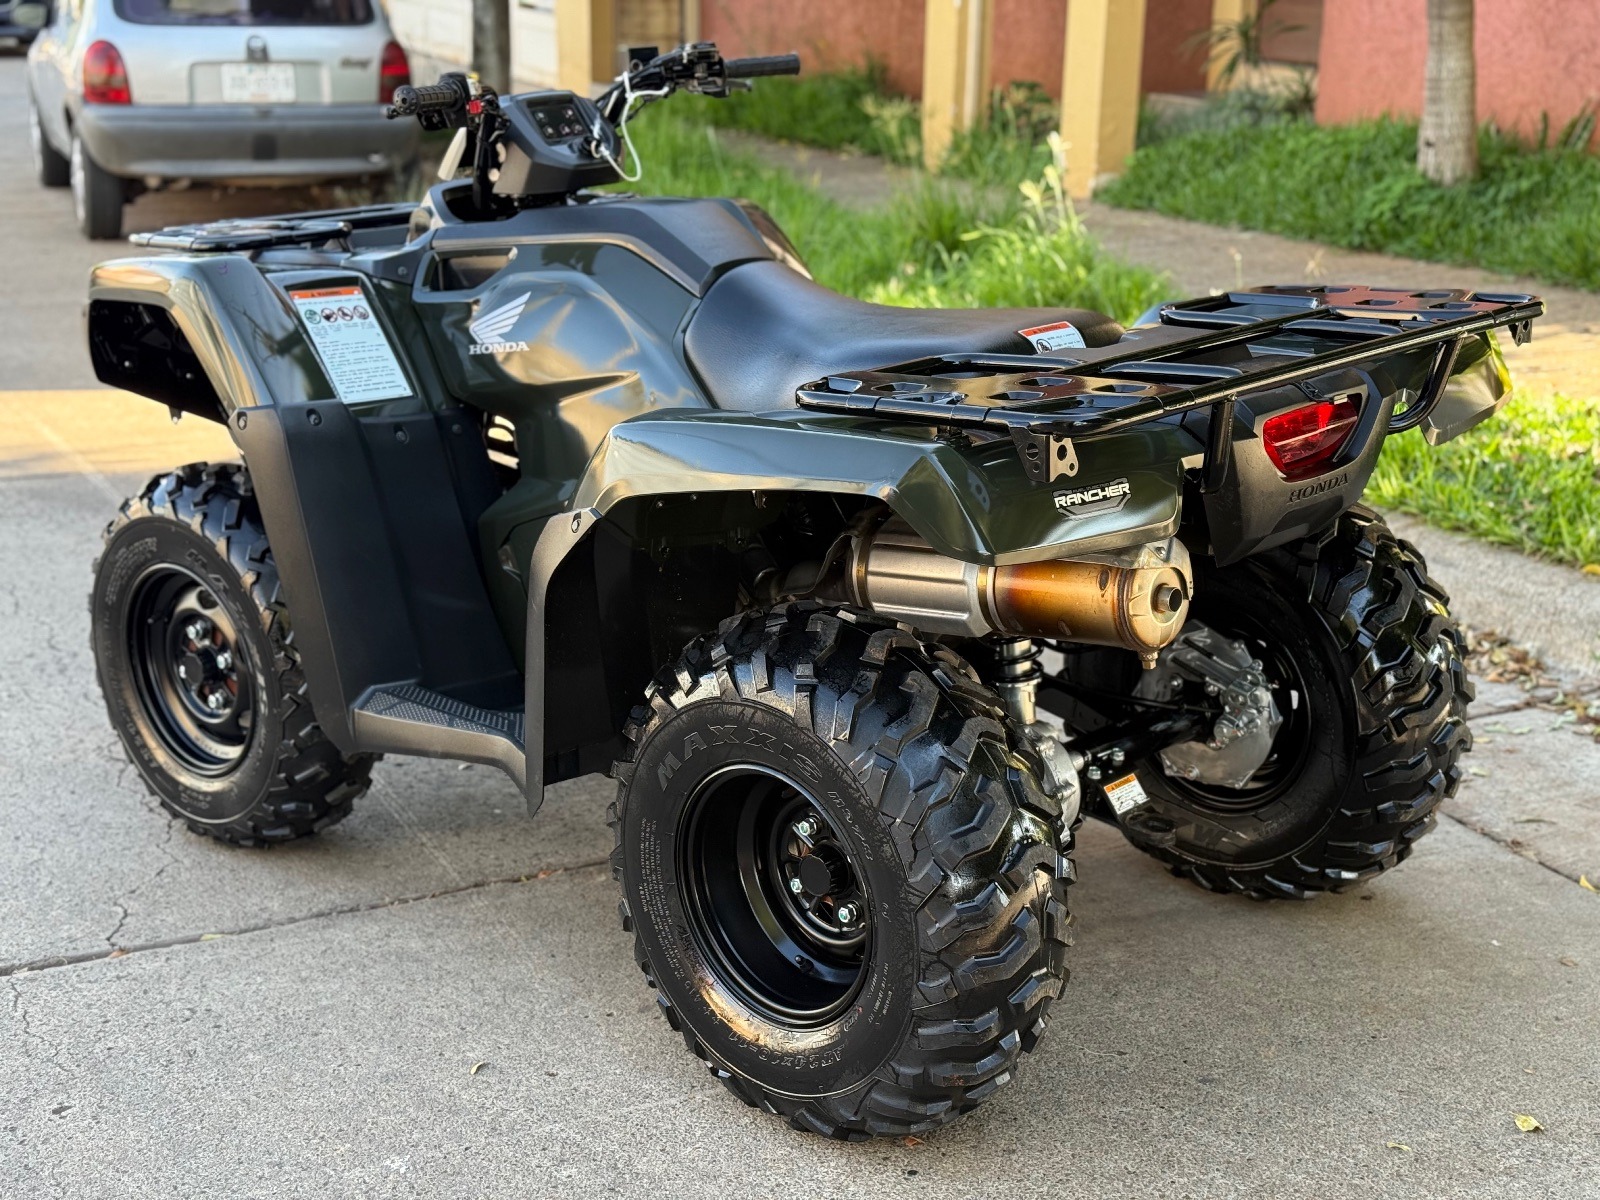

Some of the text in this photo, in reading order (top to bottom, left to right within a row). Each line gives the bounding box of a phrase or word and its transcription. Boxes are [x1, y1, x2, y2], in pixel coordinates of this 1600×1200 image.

[468, 341, 530, 355] HONDA
[1054, 482, 1131, 509] RANCHER
[1287, 472, 1349, 503] HONDA
[656, 724, 823, 792] MAXXIS
